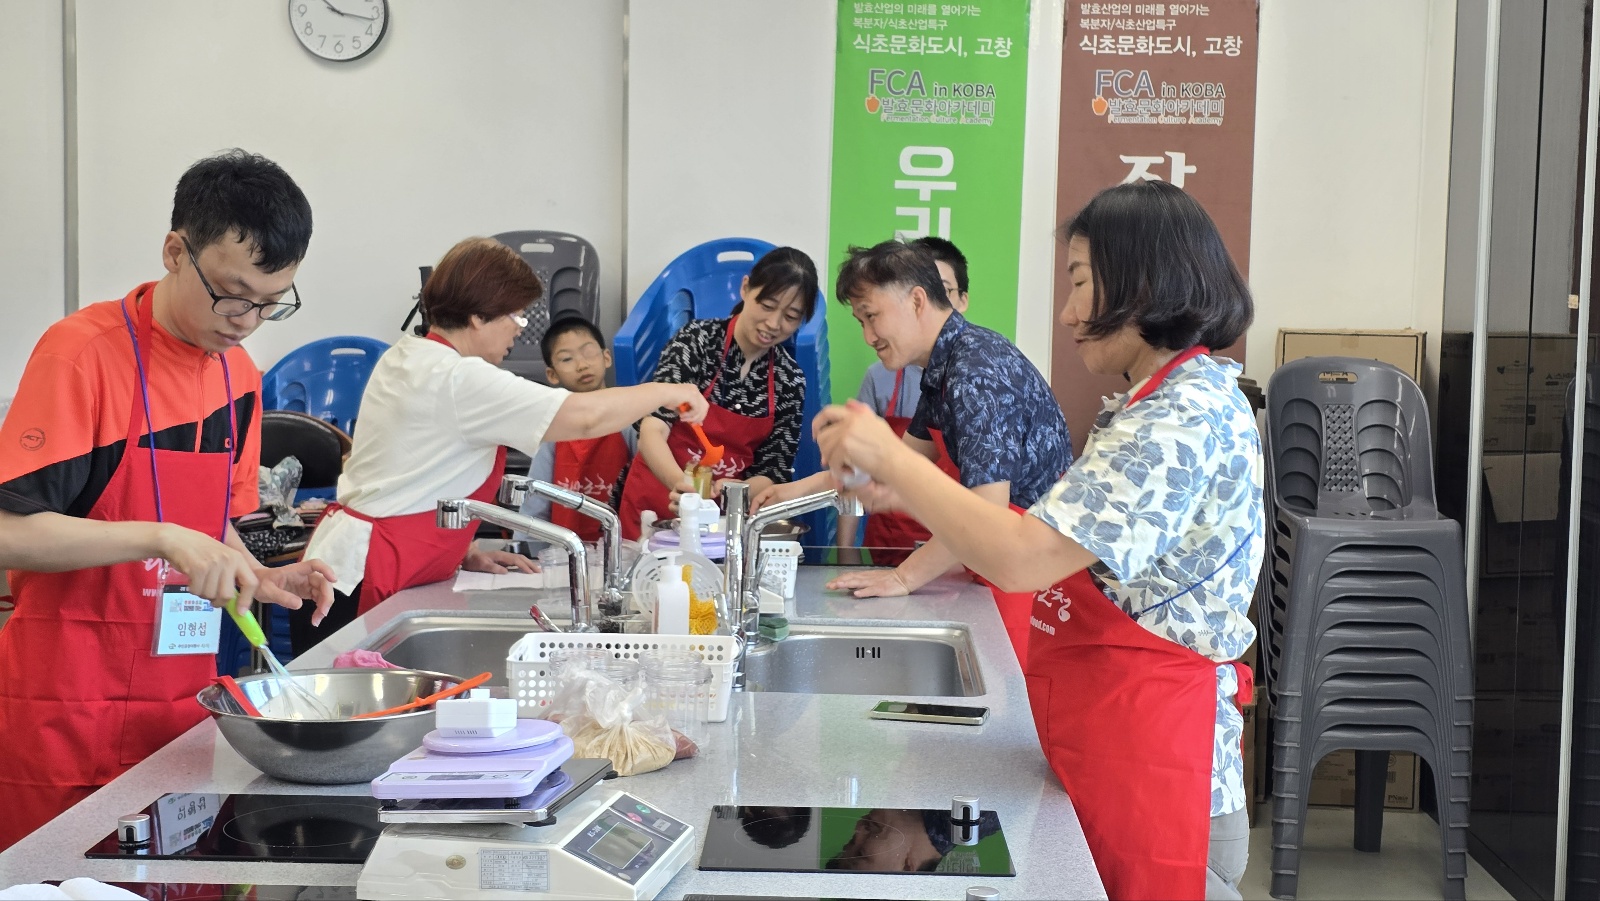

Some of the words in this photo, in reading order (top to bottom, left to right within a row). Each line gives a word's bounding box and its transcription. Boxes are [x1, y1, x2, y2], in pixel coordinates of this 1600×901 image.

[298, 4, 307, 17] 9
[853, 2, 904, 14] 발효산업의
[907, 4, 938, 15] 미래를
[941, 5, 982, 16] 열어가는
[1080, 3, 1132, 15] 발효산업의
[1135, 4, 1166, 16] 미래를
[1169, 4, 1210, 16] 열어가는
[304, 21, 313, 36] 8
[365, 23, 373, 36] 4
[853, 17, 949, 31] 복분자/식초산업특구
[1079, 18, 1177, 31] 복분자/식초산업특구
[318, 34, 327, 48] 7
[334, 40, 343, 53] 6
[352, 36, 361, 49] 5
[853, 33, 968, 58] 식초문화도시,
[974, 37, 1013, 58] 고창
[1079, 34, 1197, 58] 식초문화도시,
[1203, 35, 1243, 57] 고창
[868, 68, 927, 97] FCA
[933, 82, 948, 98] in
[951, 83, 997, 98] KOBA
[1095, 69, 1156, 98] FCA
[1160, 81, 1177, 98] in
[1180, 82, 1226, 98] KOBA
[881, 97, 996, 117] 발효문화아카데미
[1108, 97, 1225, 117] 발효문화아카데미
[177, 621, 207, 637] 임형섭
